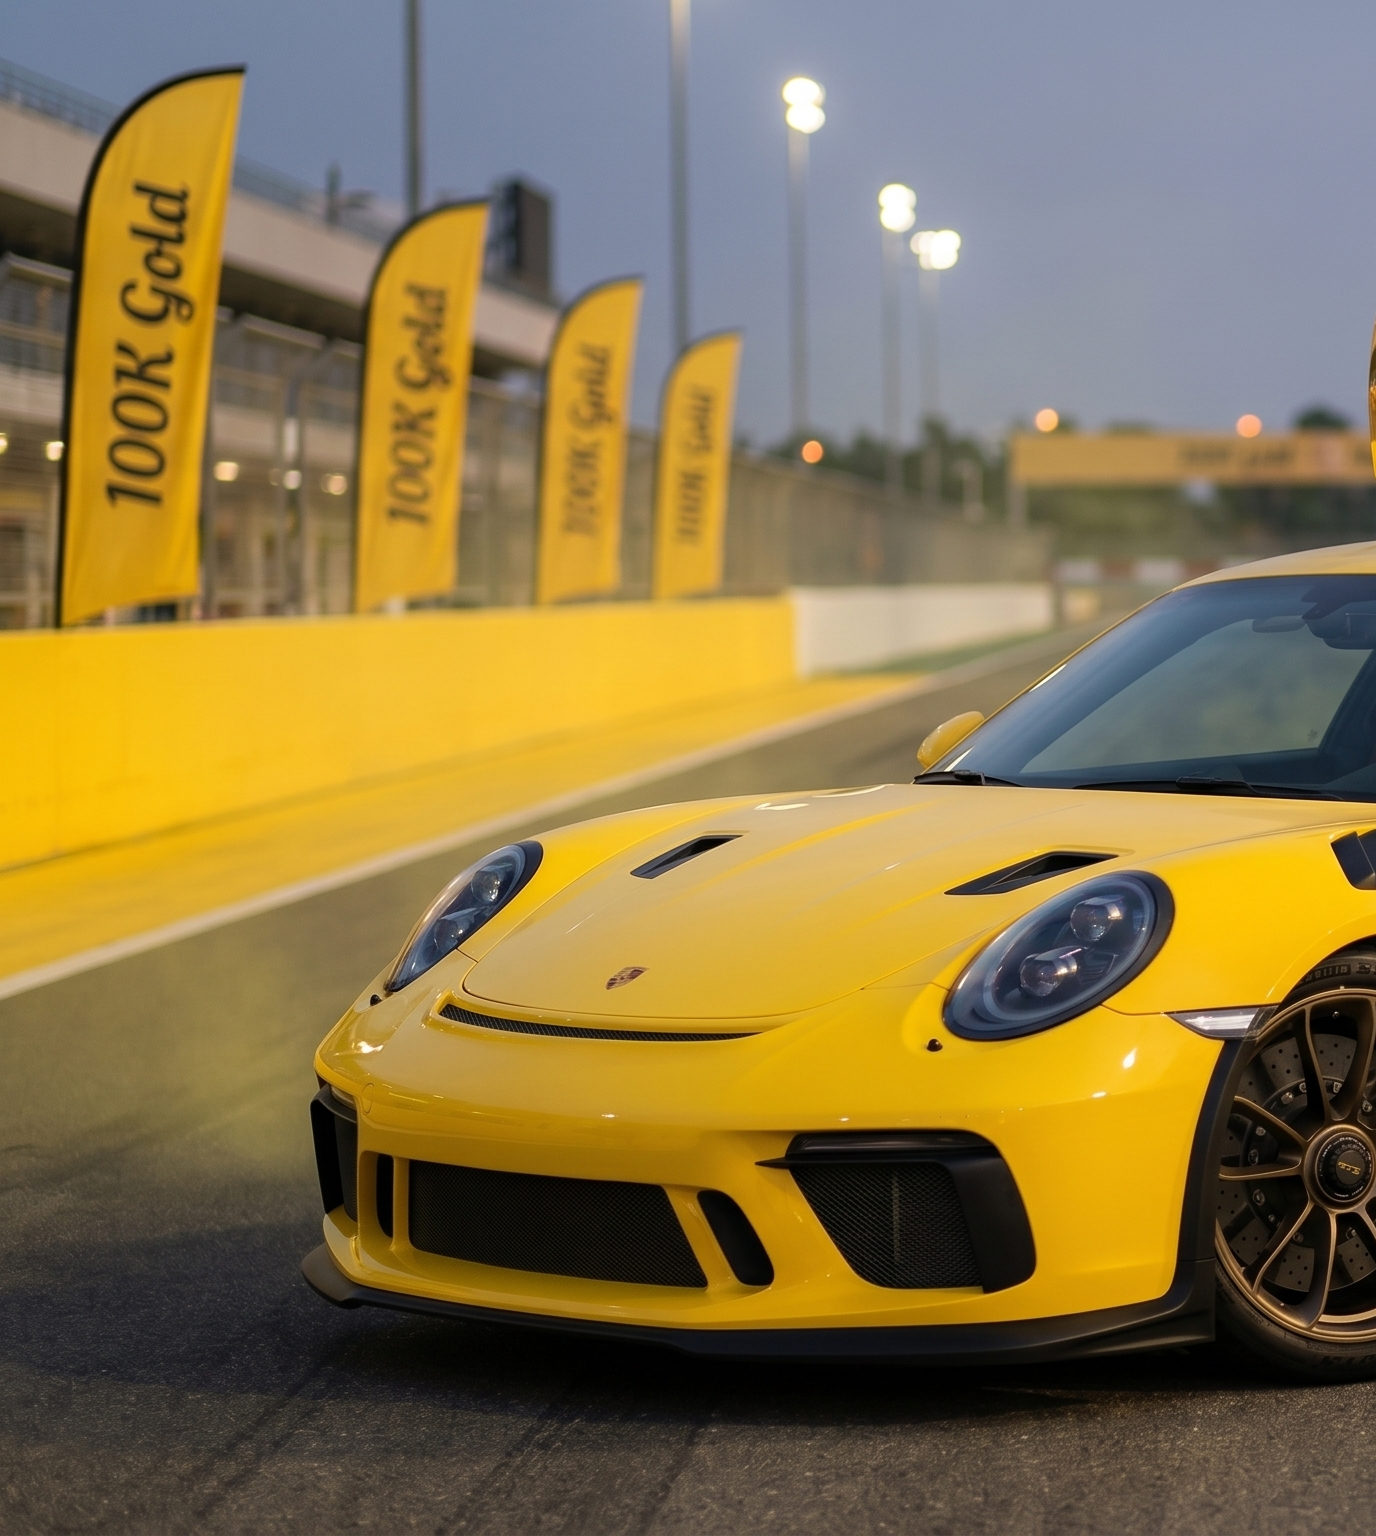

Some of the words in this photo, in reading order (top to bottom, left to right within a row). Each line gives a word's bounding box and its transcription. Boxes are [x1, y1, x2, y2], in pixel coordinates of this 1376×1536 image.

[120, 179, 194, 327] Gold
[394, 281, 454, 393] Gold
[106, 341, 175, 508] 100K
[386, 401, 437, 526] 100K
